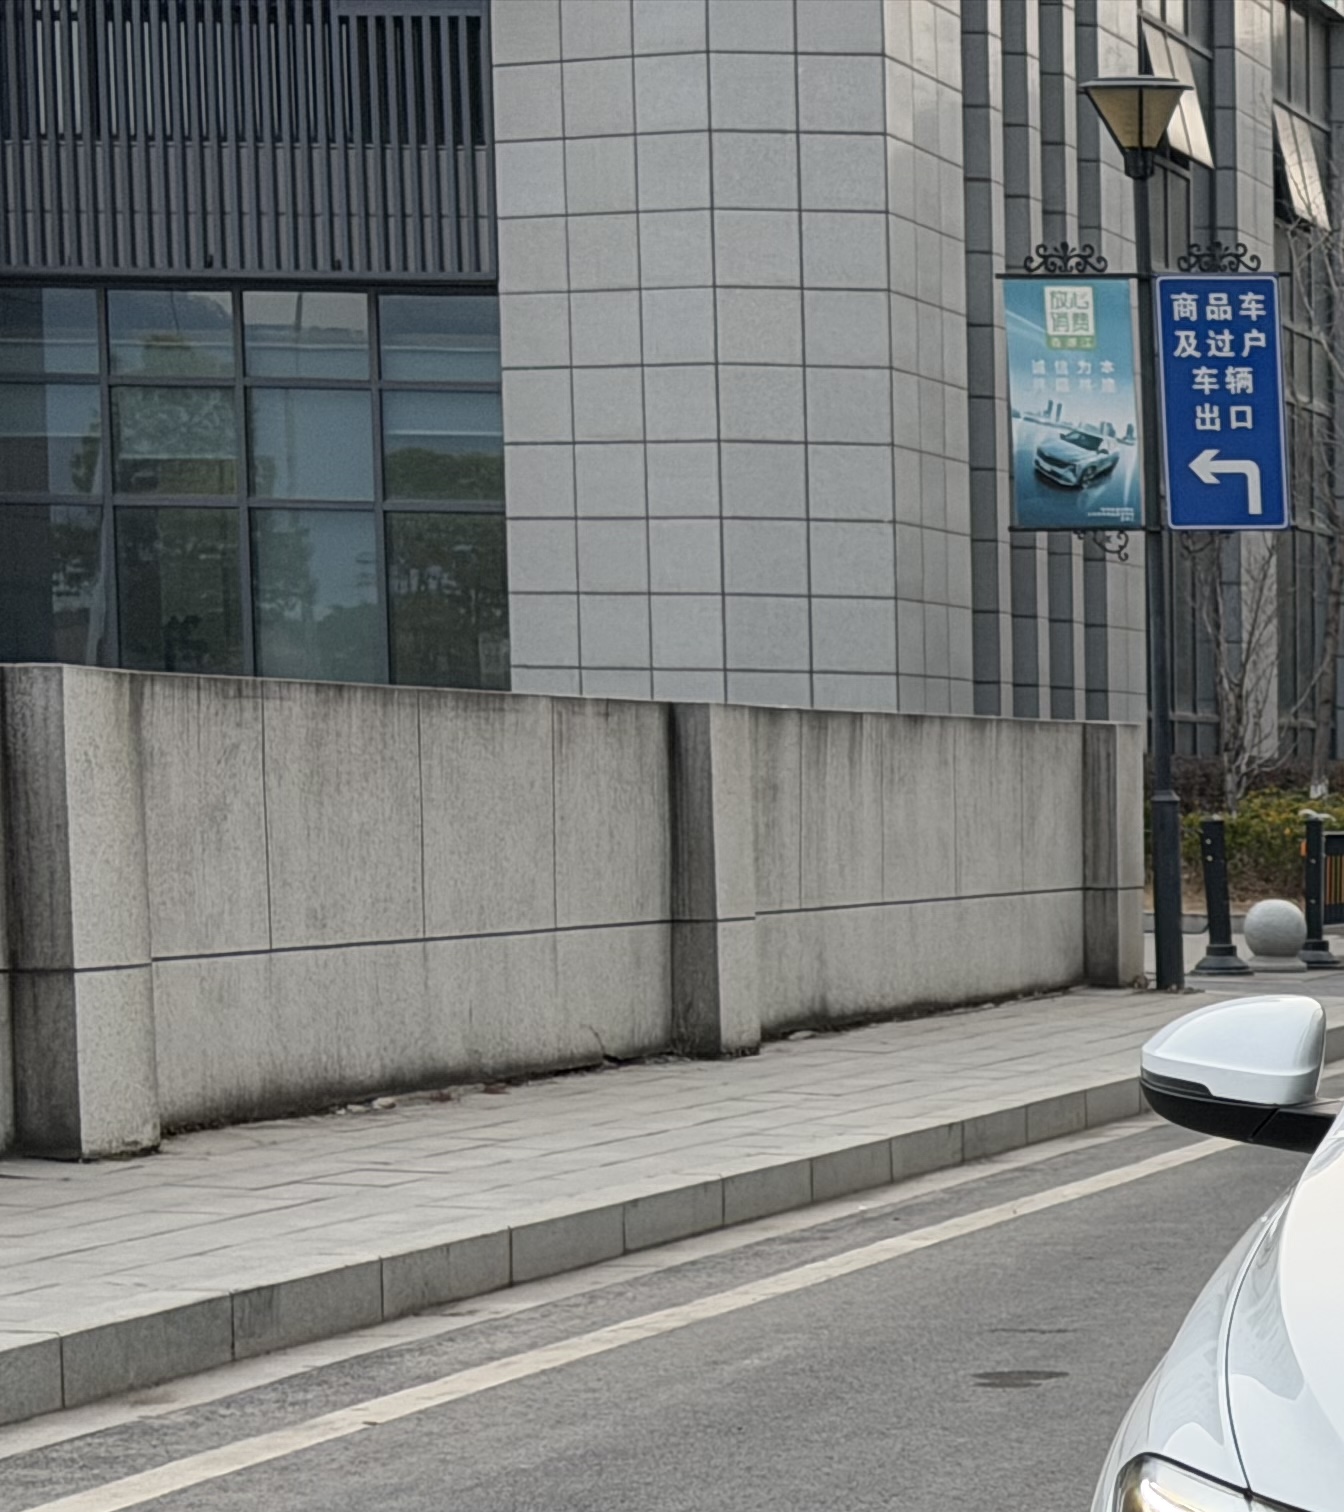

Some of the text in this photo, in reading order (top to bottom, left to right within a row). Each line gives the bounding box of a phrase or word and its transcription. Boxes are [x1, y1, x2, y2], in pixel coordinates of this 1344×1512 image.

[1170, 292, 1267, 322] 商品车
[1173, 329, 1267, 358] 及过户
[1192, 366, 1254, 395] 车辆
[1194, 403, 1254, 432] 出口
